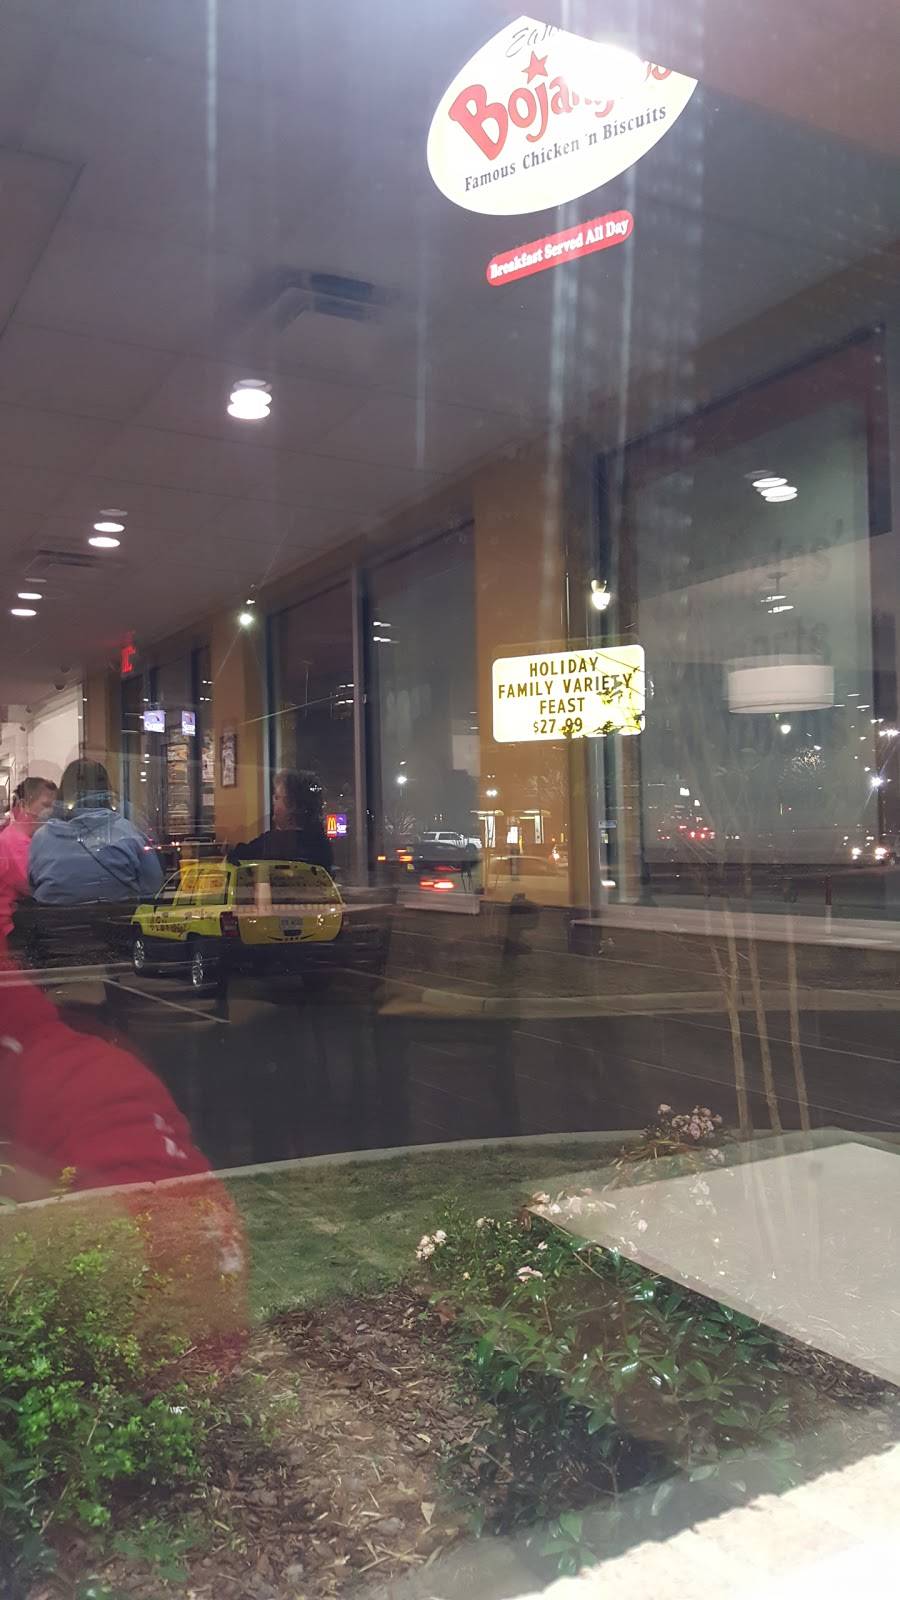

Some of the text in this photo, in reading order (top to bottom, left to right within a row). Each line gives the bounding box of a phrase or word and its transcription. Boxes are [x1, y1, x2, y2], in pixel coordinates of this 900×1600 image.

[465, 162, 516, 192] Famous
[523, 139, 579, 170] Chicken
[603, 106, 666, 140] Biscuits
[490, 219, 629, 279] Breakfast Served All Day
[529, 656, 599, 677] HOLIDAY
[498, 673, 633, 699] FAMILY VARIETY
[539, 697, 586, 714] FEAST
[533, 717, 583, 734] $2799
